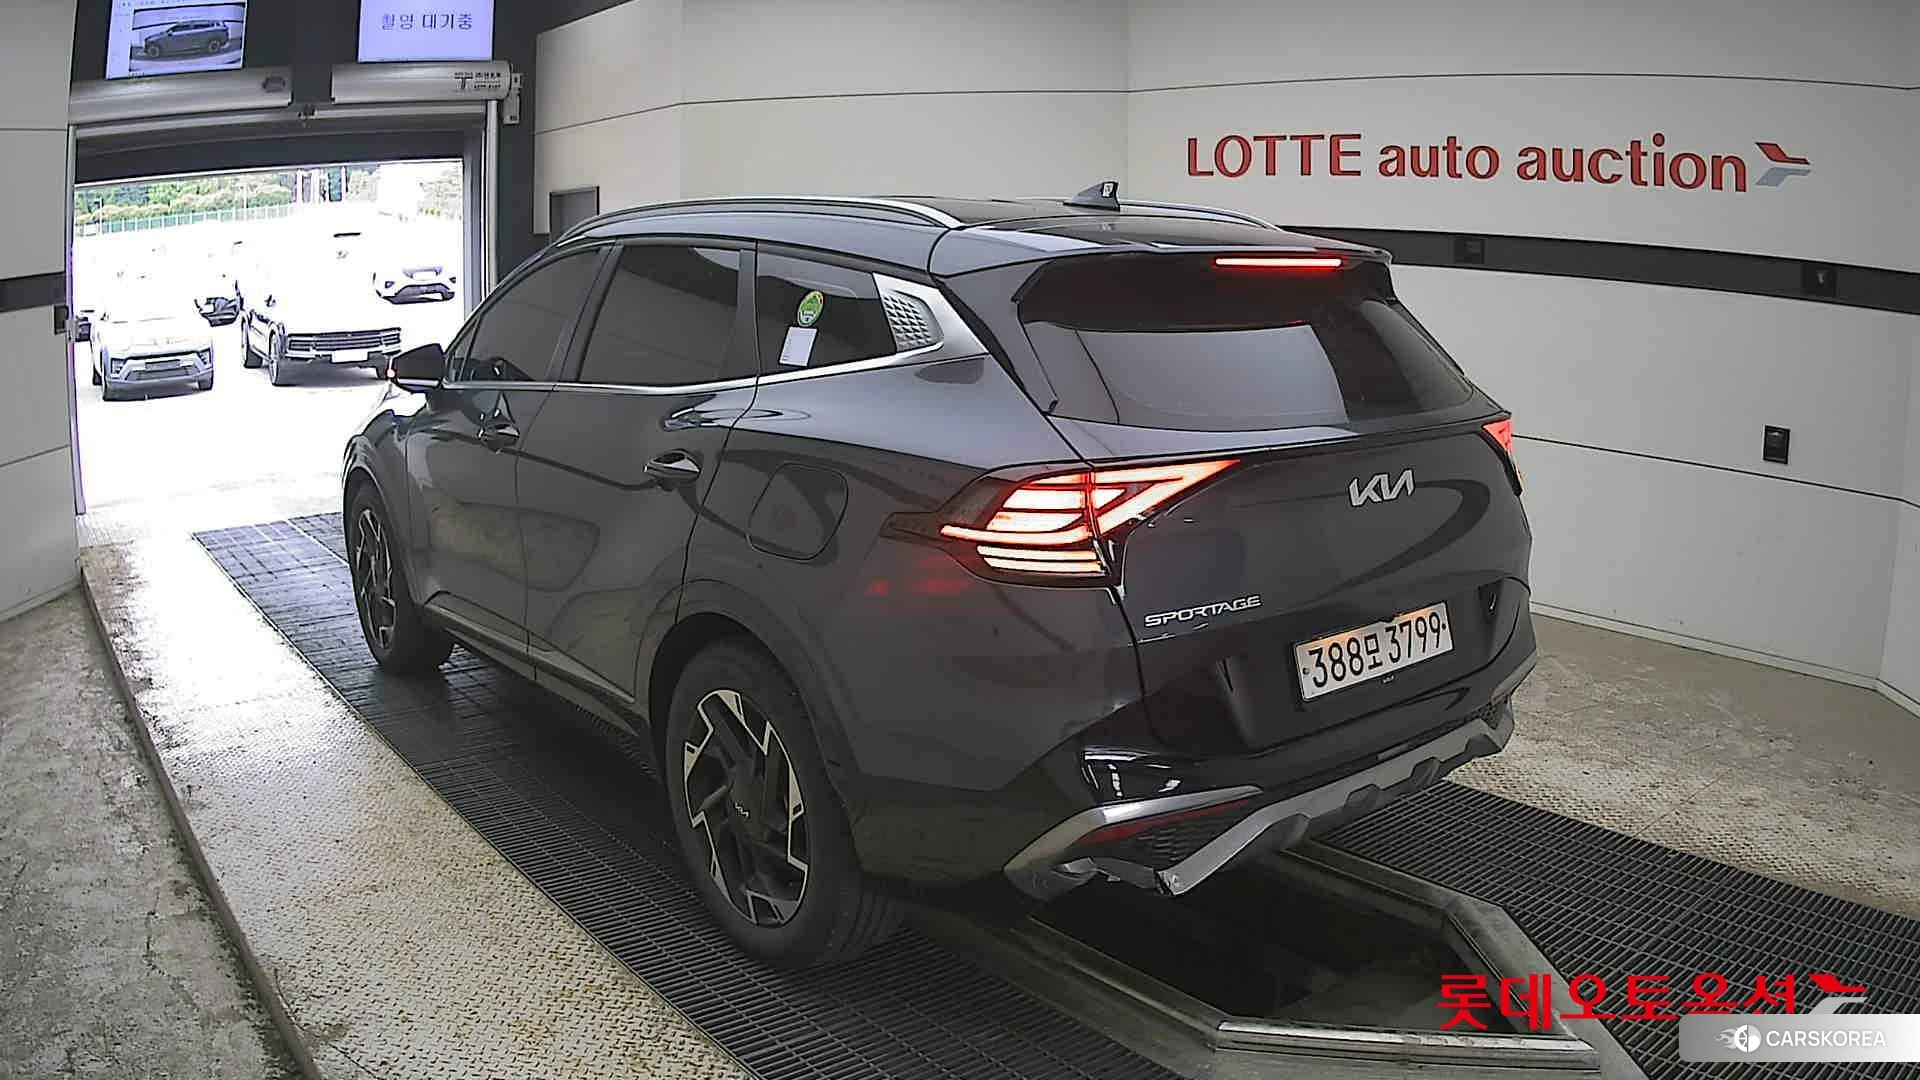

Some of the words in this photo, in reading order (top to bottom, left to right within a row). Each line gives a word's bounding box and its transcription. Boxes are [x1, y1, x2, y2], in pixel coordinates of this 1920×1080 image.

[422, 13, 473, 31] 대기중
[1186, 133, 1363, 178] LOTTE
[1378, 135, 1500, 179] auto
[1515, 132, 1748, 193] auction
[1349, 469, 1414, 506] KIA
[1144, 595, 1262, 627] SPORTAGE
